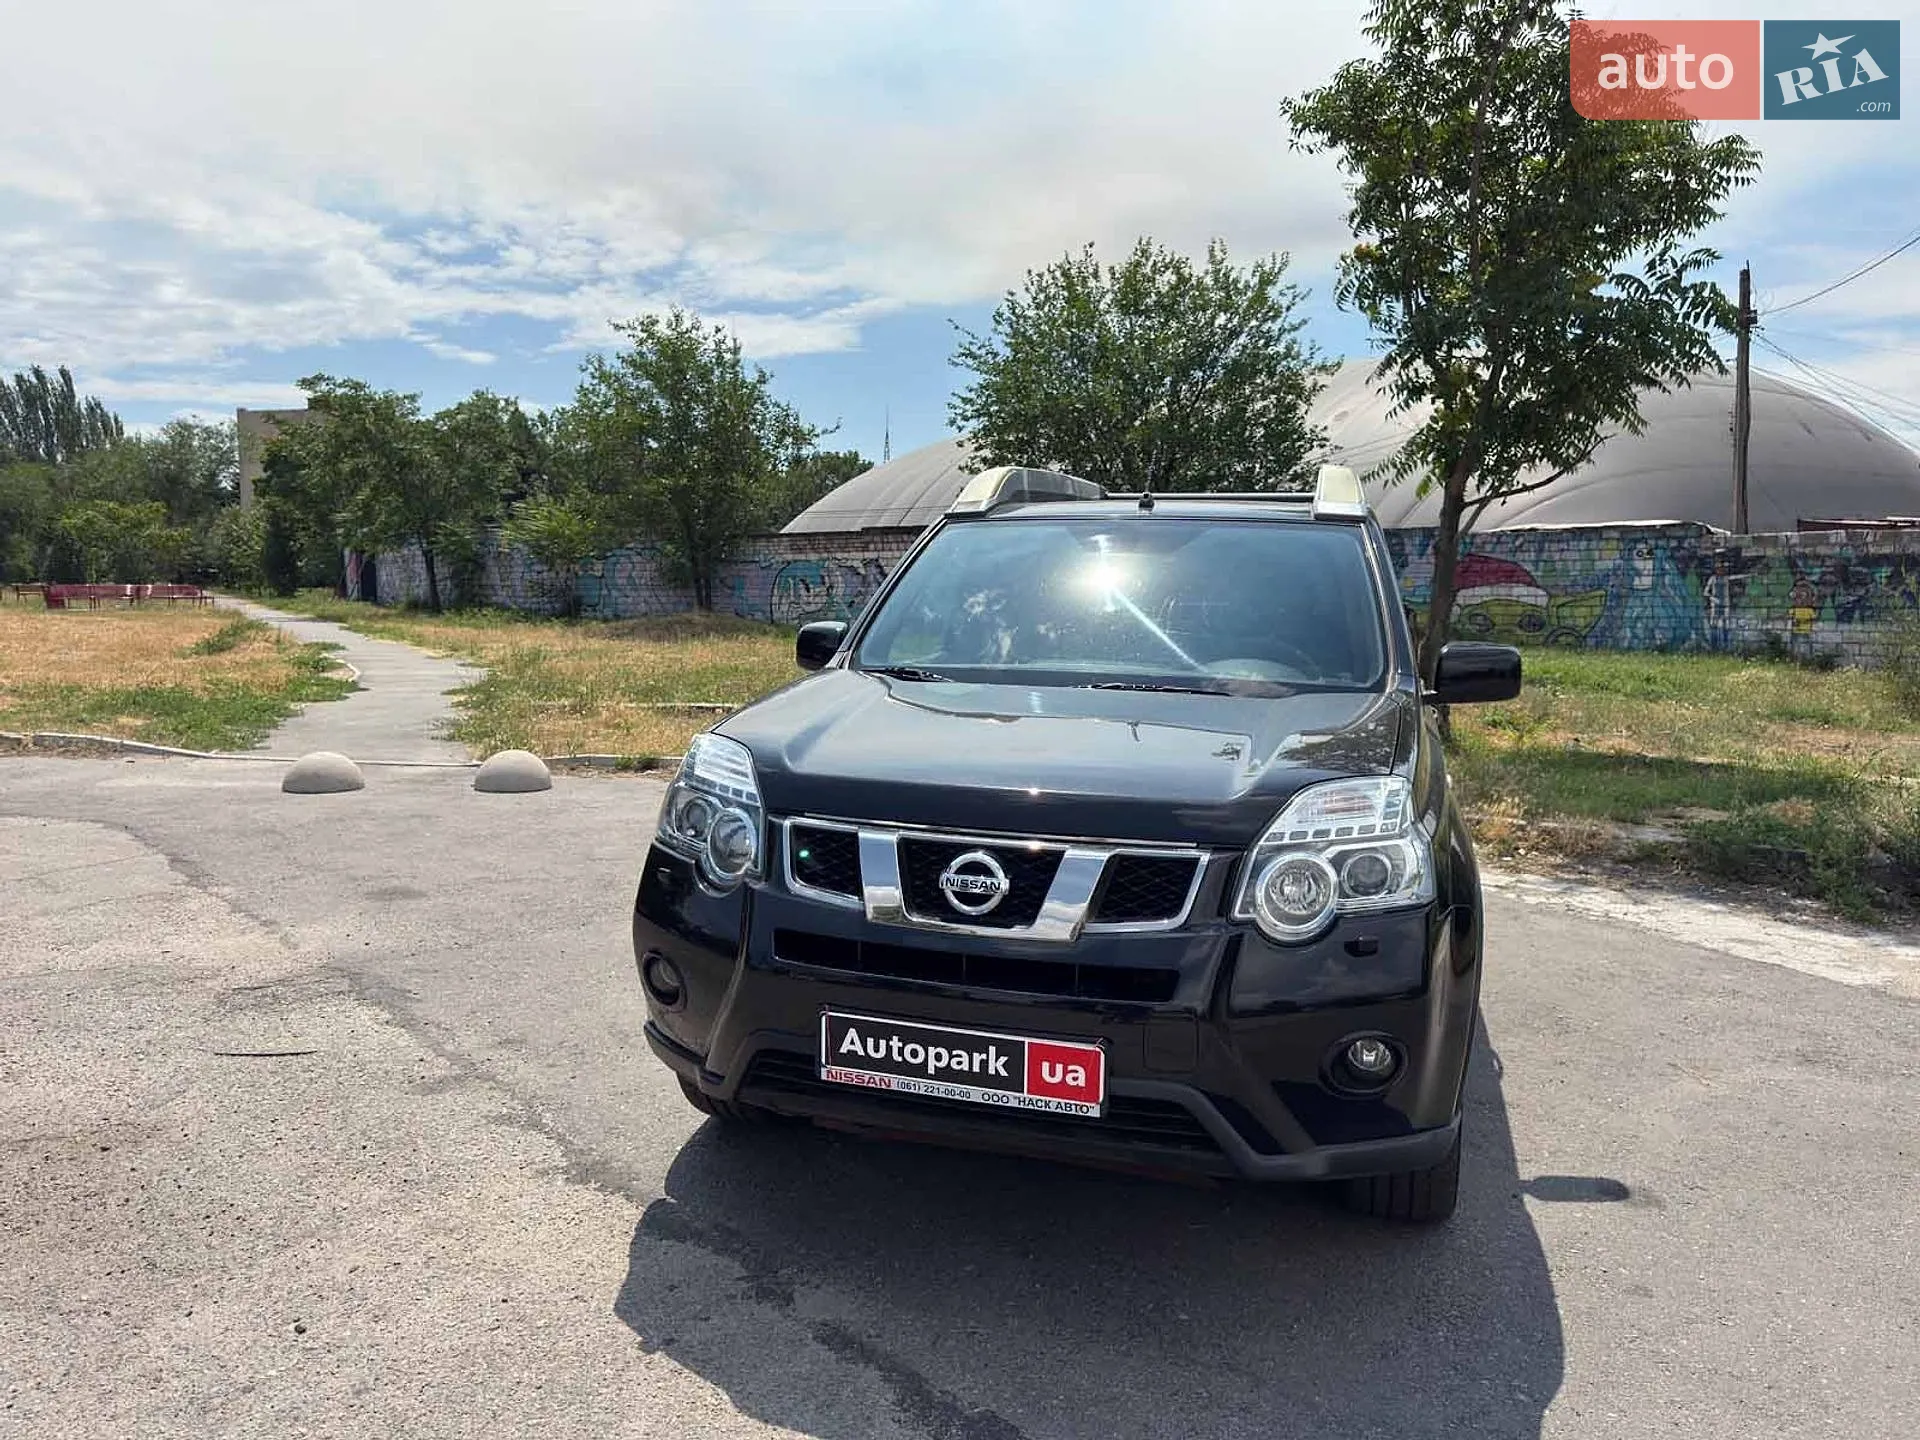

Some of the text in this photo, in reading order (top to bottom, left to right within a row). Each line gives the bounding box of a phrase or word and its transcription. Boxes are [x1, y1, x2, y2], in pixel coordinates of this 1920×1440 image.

[945, 876, 1001, 891] NISSAN
[839, 1027, 1009, 1078] Autopark
[826, 1070, 892, 1089] NISSAN
[1040, 1058, 1086, 1088] ua
[896, 1079, 921, 1093] (061)
